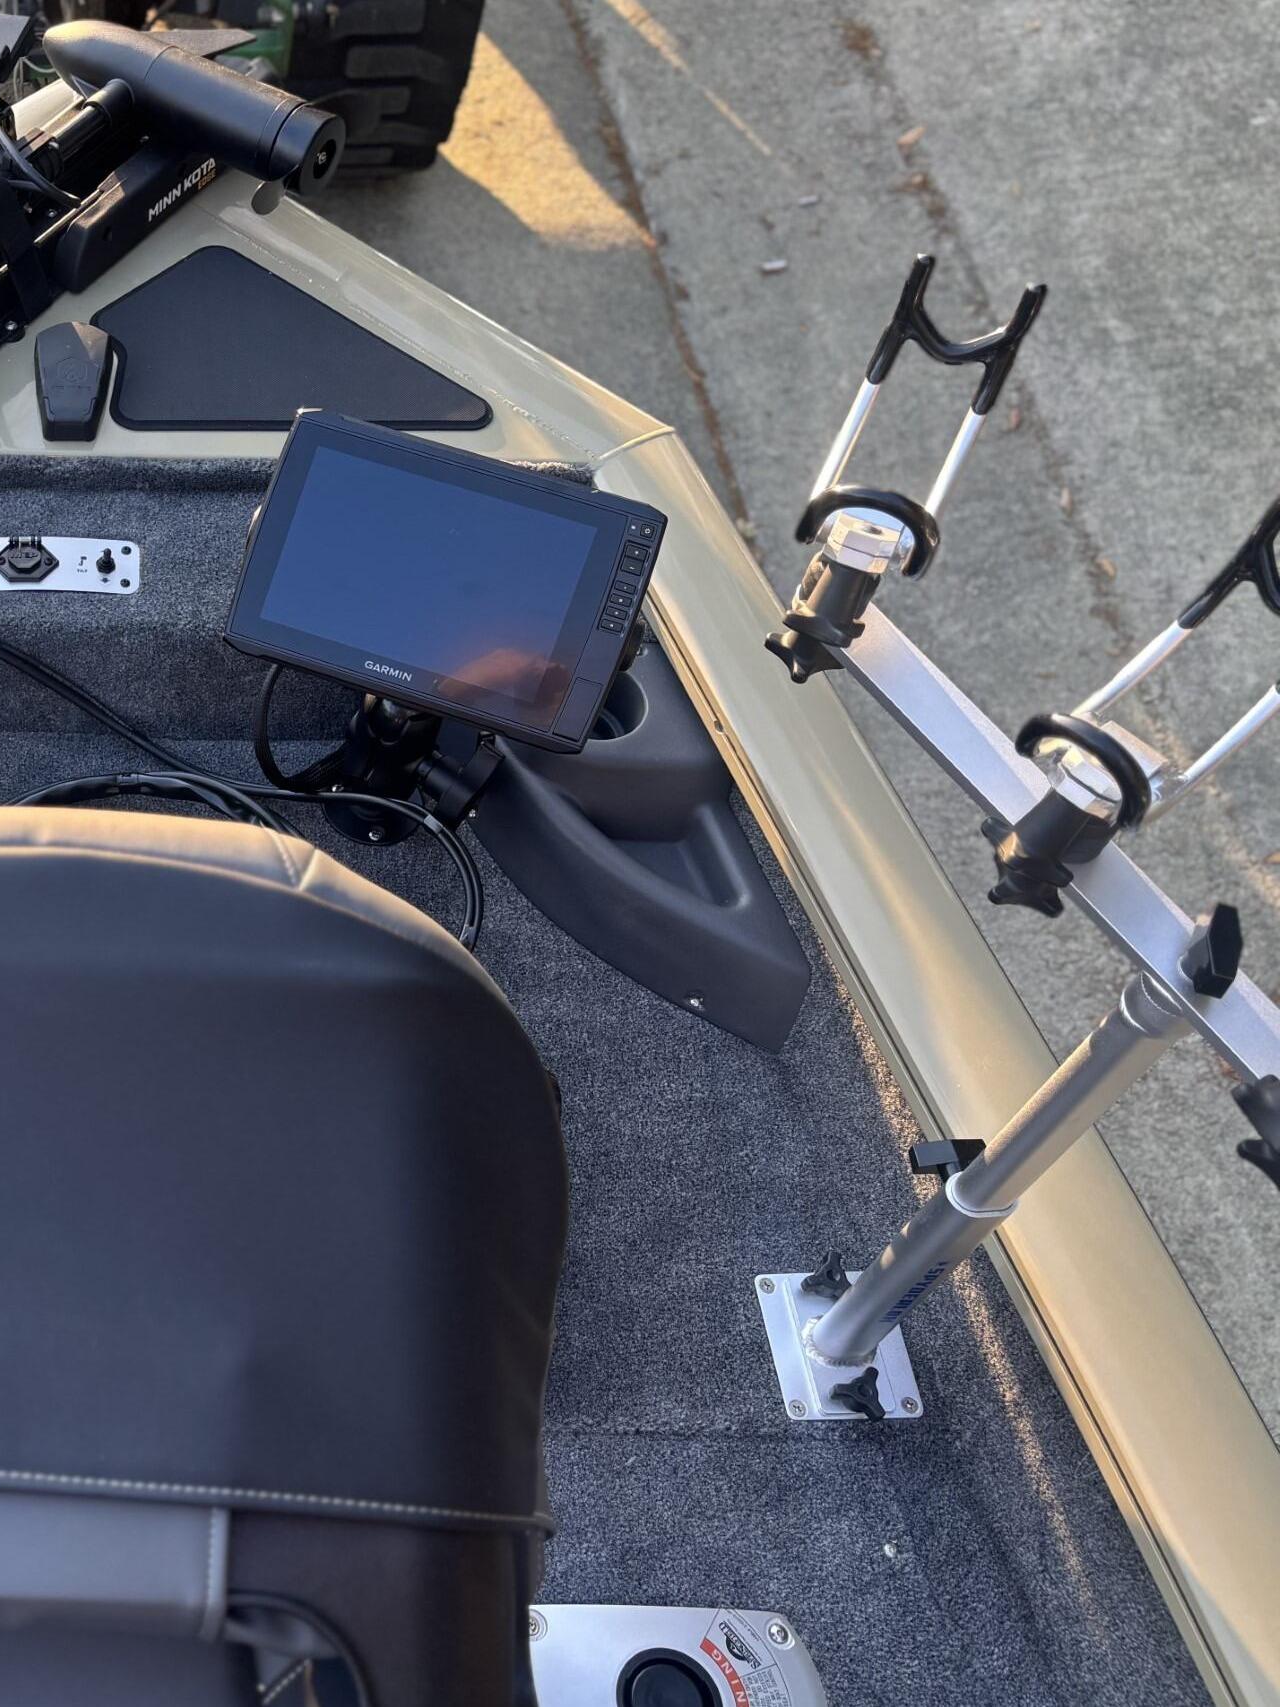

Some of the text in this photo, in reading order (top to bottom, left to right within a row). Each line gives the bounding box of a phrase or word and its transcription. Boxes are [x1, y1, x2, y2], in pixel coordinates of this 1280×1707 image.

[148, 157, 216, 222] MINN KOTA
[364, 660, 412, 682] GARMIN
